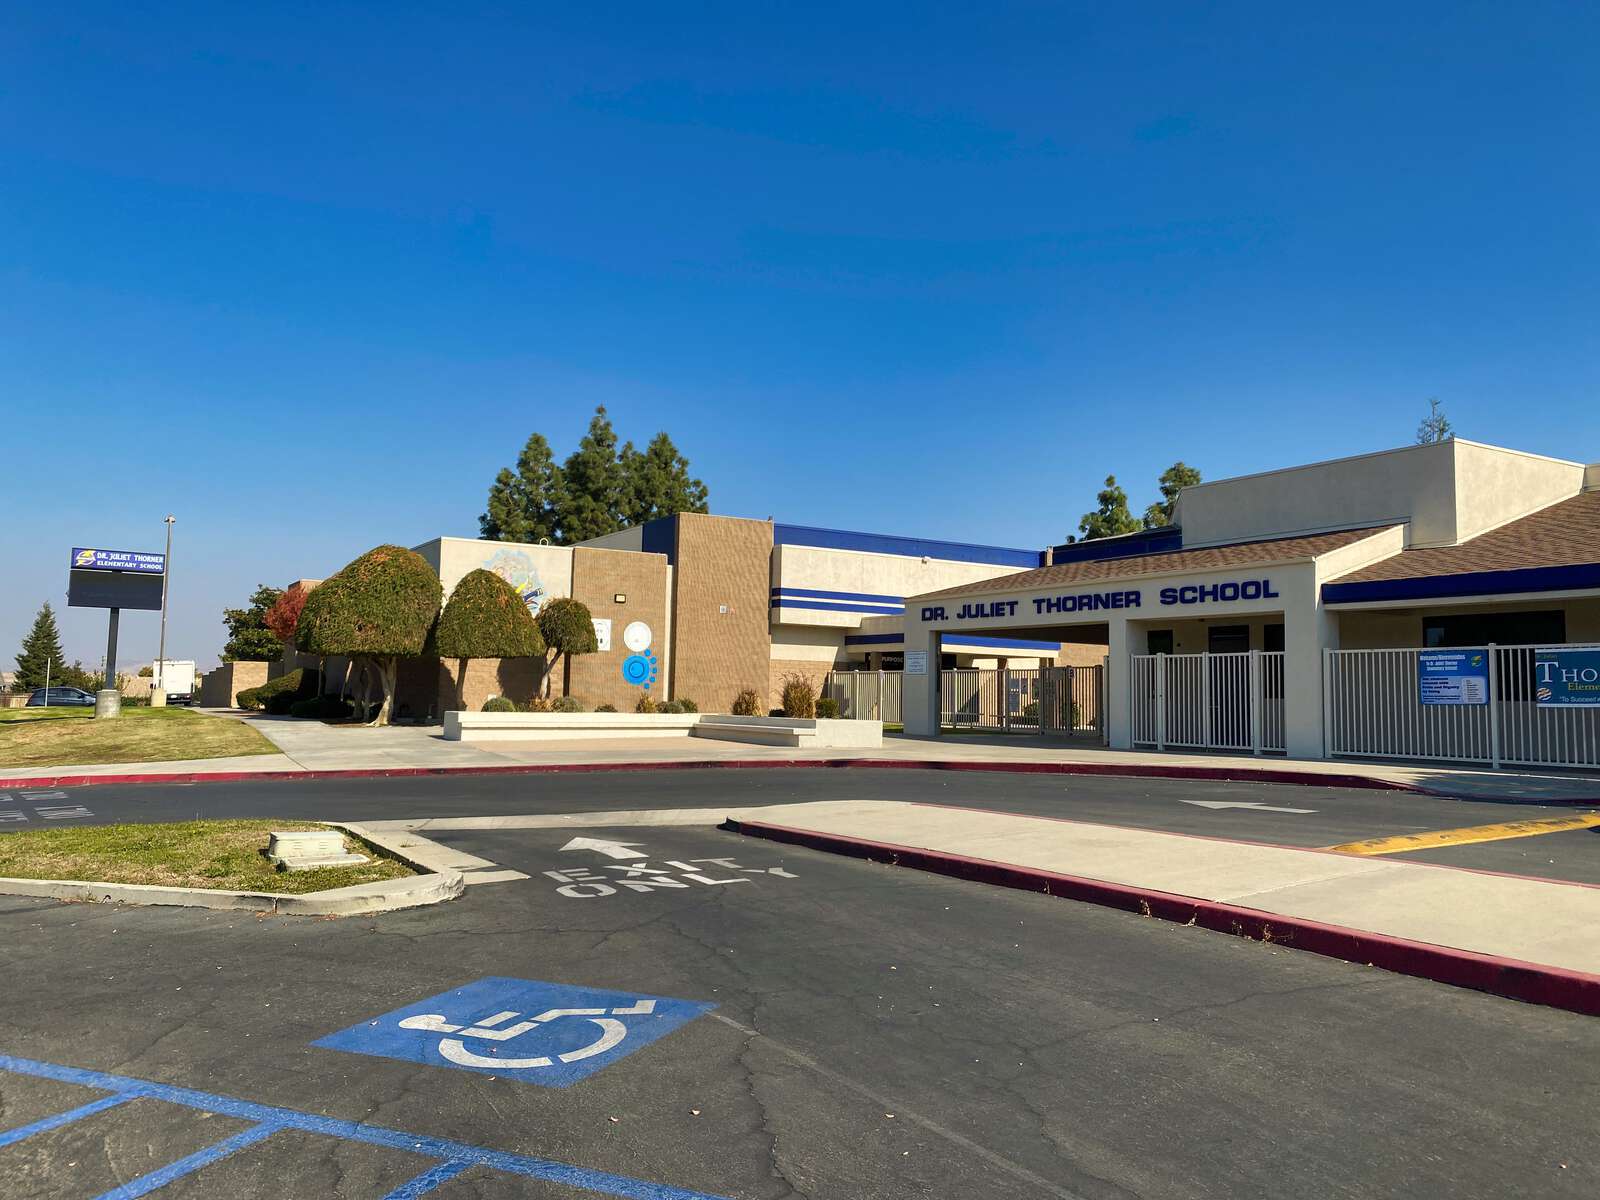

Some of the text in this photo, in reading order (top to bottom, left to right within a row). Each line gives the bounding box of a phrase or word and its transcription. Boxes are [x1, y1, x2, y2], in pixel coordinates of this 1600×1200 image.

[97, 552, 164, 563] DR. JULIET THORNER
[921, 579, 1280, 622] DR. JULIET THORNER SCHOOL
[541, 857, 743, 883] EXIT
[555, 867, 800, 898] ONLY
